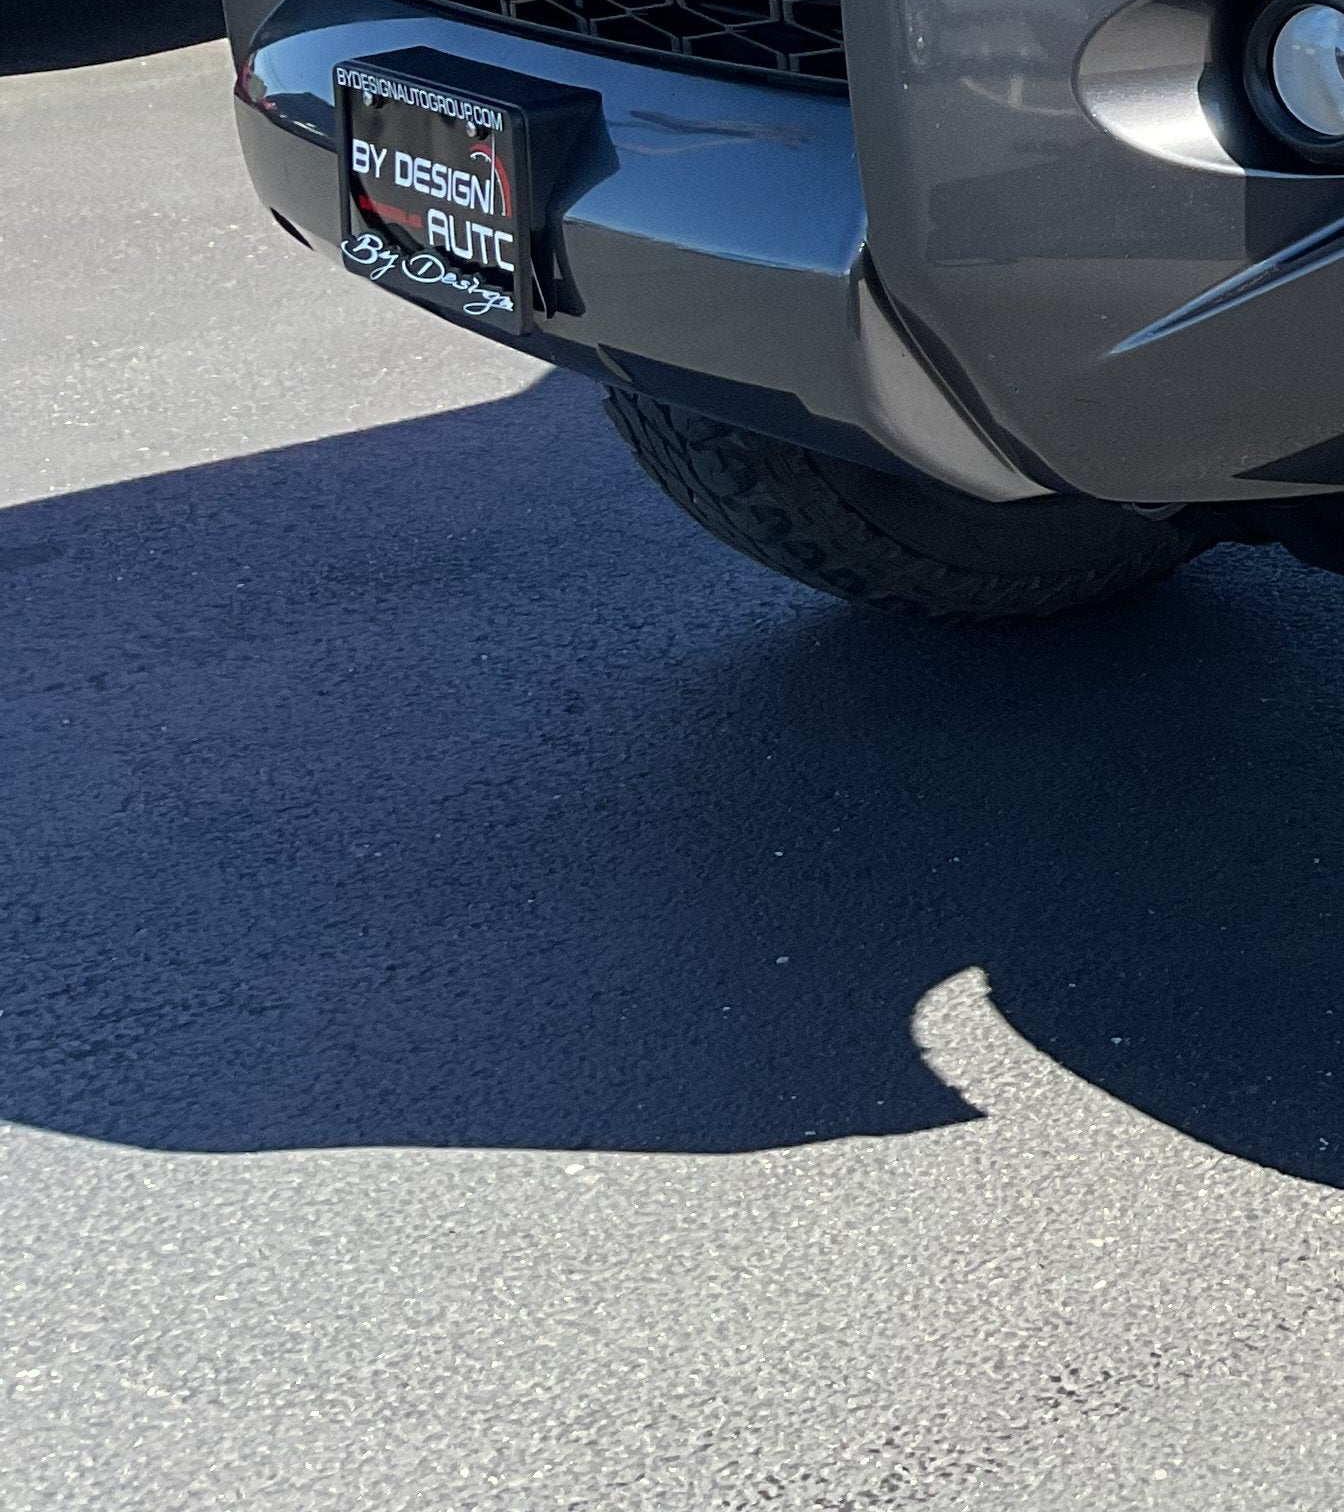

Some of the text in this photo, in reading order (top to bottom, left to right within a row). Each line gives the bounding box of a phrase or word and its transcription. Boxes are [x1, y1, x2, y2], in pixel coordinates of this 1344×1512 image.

[336, 67, 504, 132] BYDESIGNAUTOGROUP.COM
[352, 138, 494, 215] BY DESIGN
[341, 234, 399, 281] By
